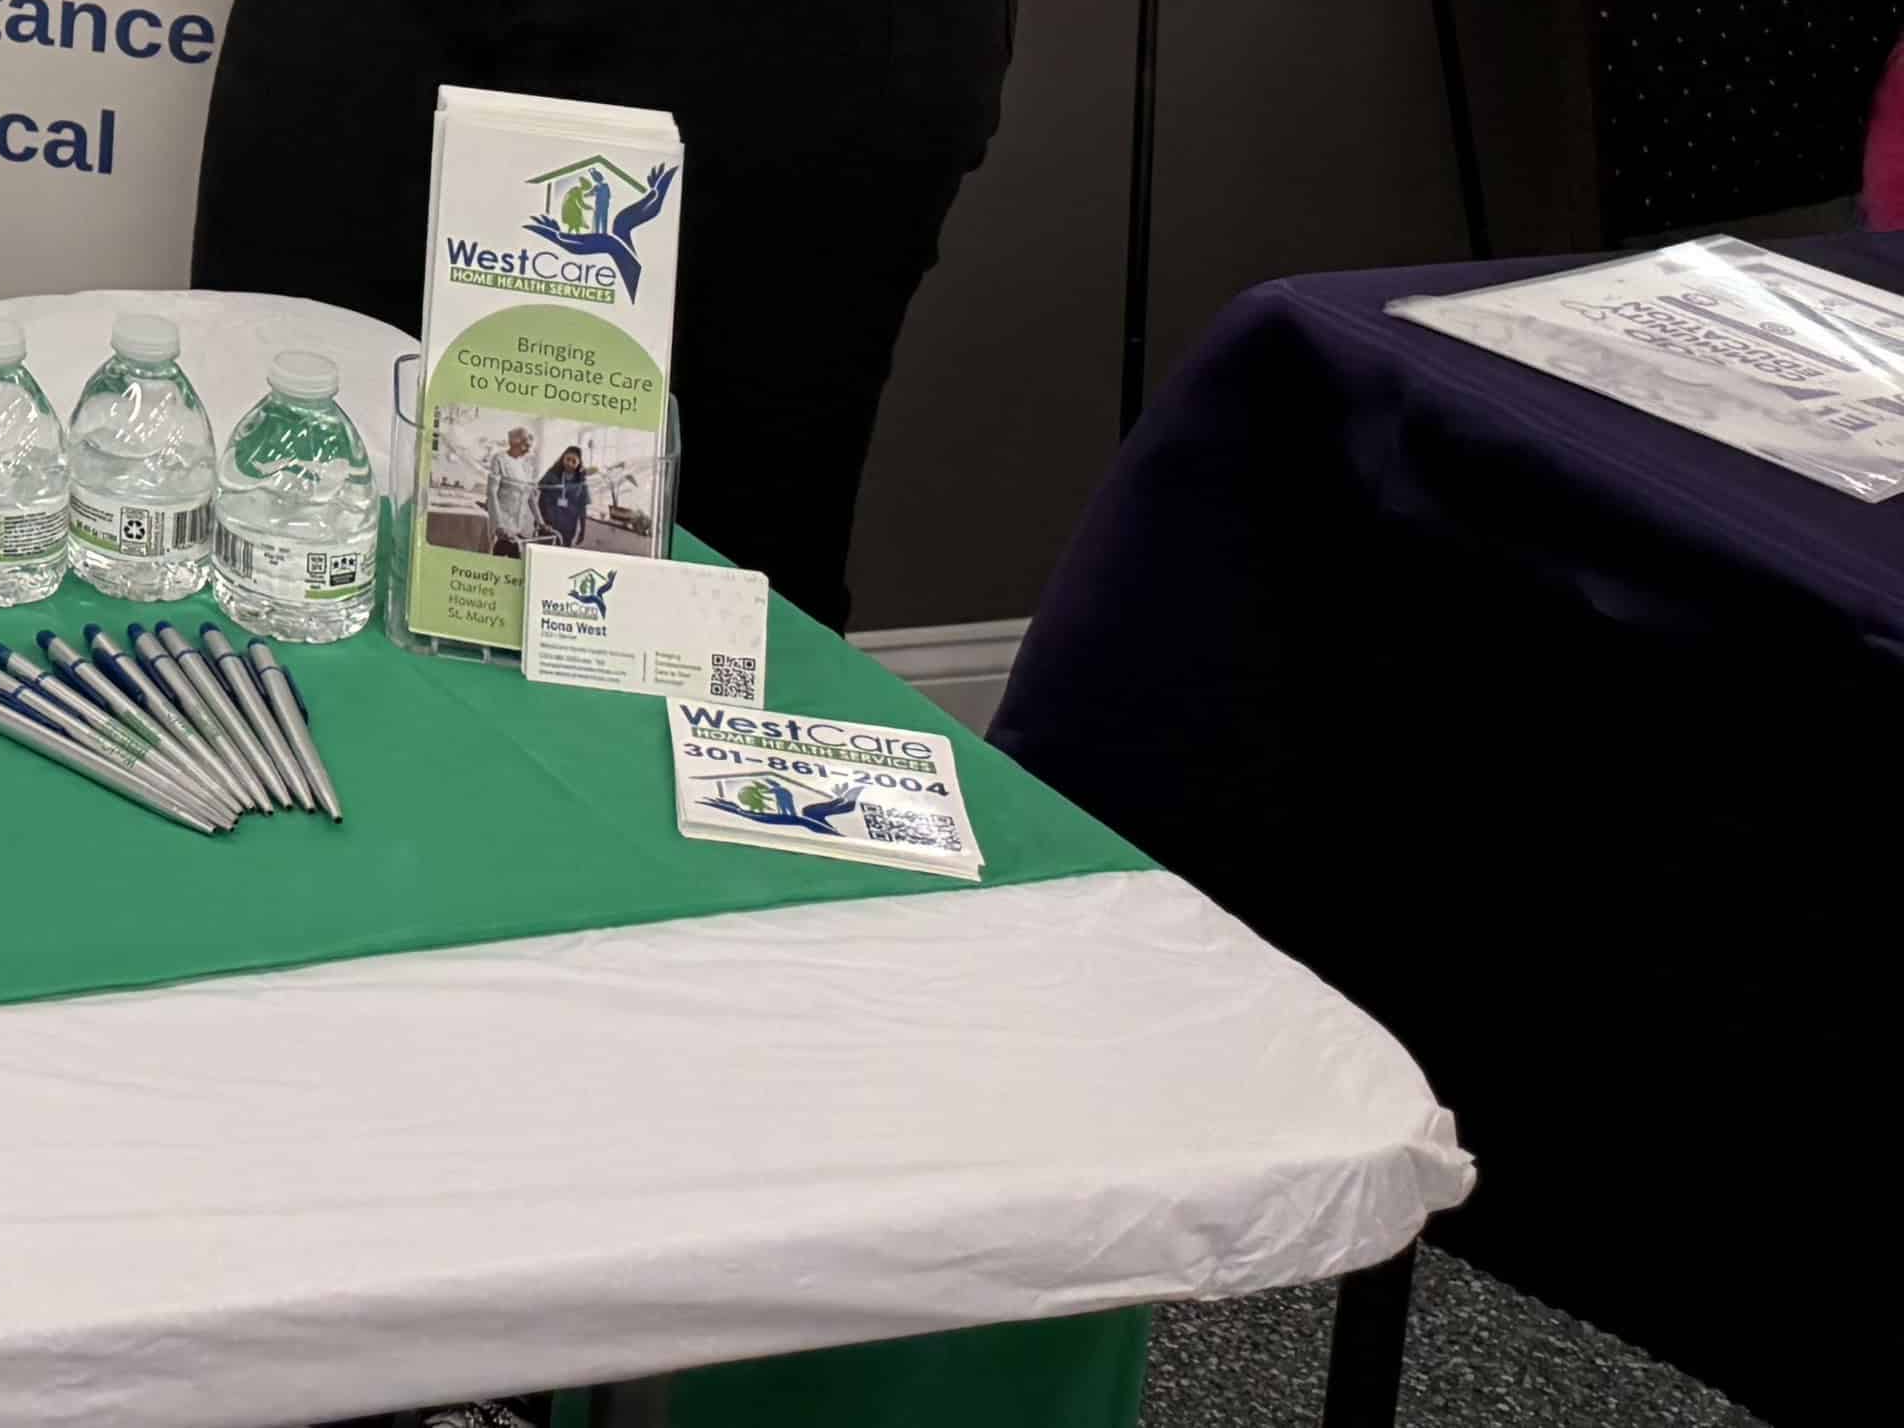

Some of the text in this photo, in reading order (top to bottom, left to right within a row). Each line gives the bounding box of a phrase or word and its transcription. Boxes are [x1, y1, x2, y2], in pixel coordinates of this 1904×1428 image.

[447, 237, 616, 287] WestCare
[452, 270, 612, 302] HOME HEALTH SERVICES
[457, 350, 654, 393] Compassionate Care
[517, 337, 596, 366] Bringing
[470, 373, 637, 414] to Your Doorstep!
[679, 704, 933, 760] WestCare
[695, 728, 933, 772] HOME HEALTH SERVICES
[684, 743, 949, 797] 301-861-2004
